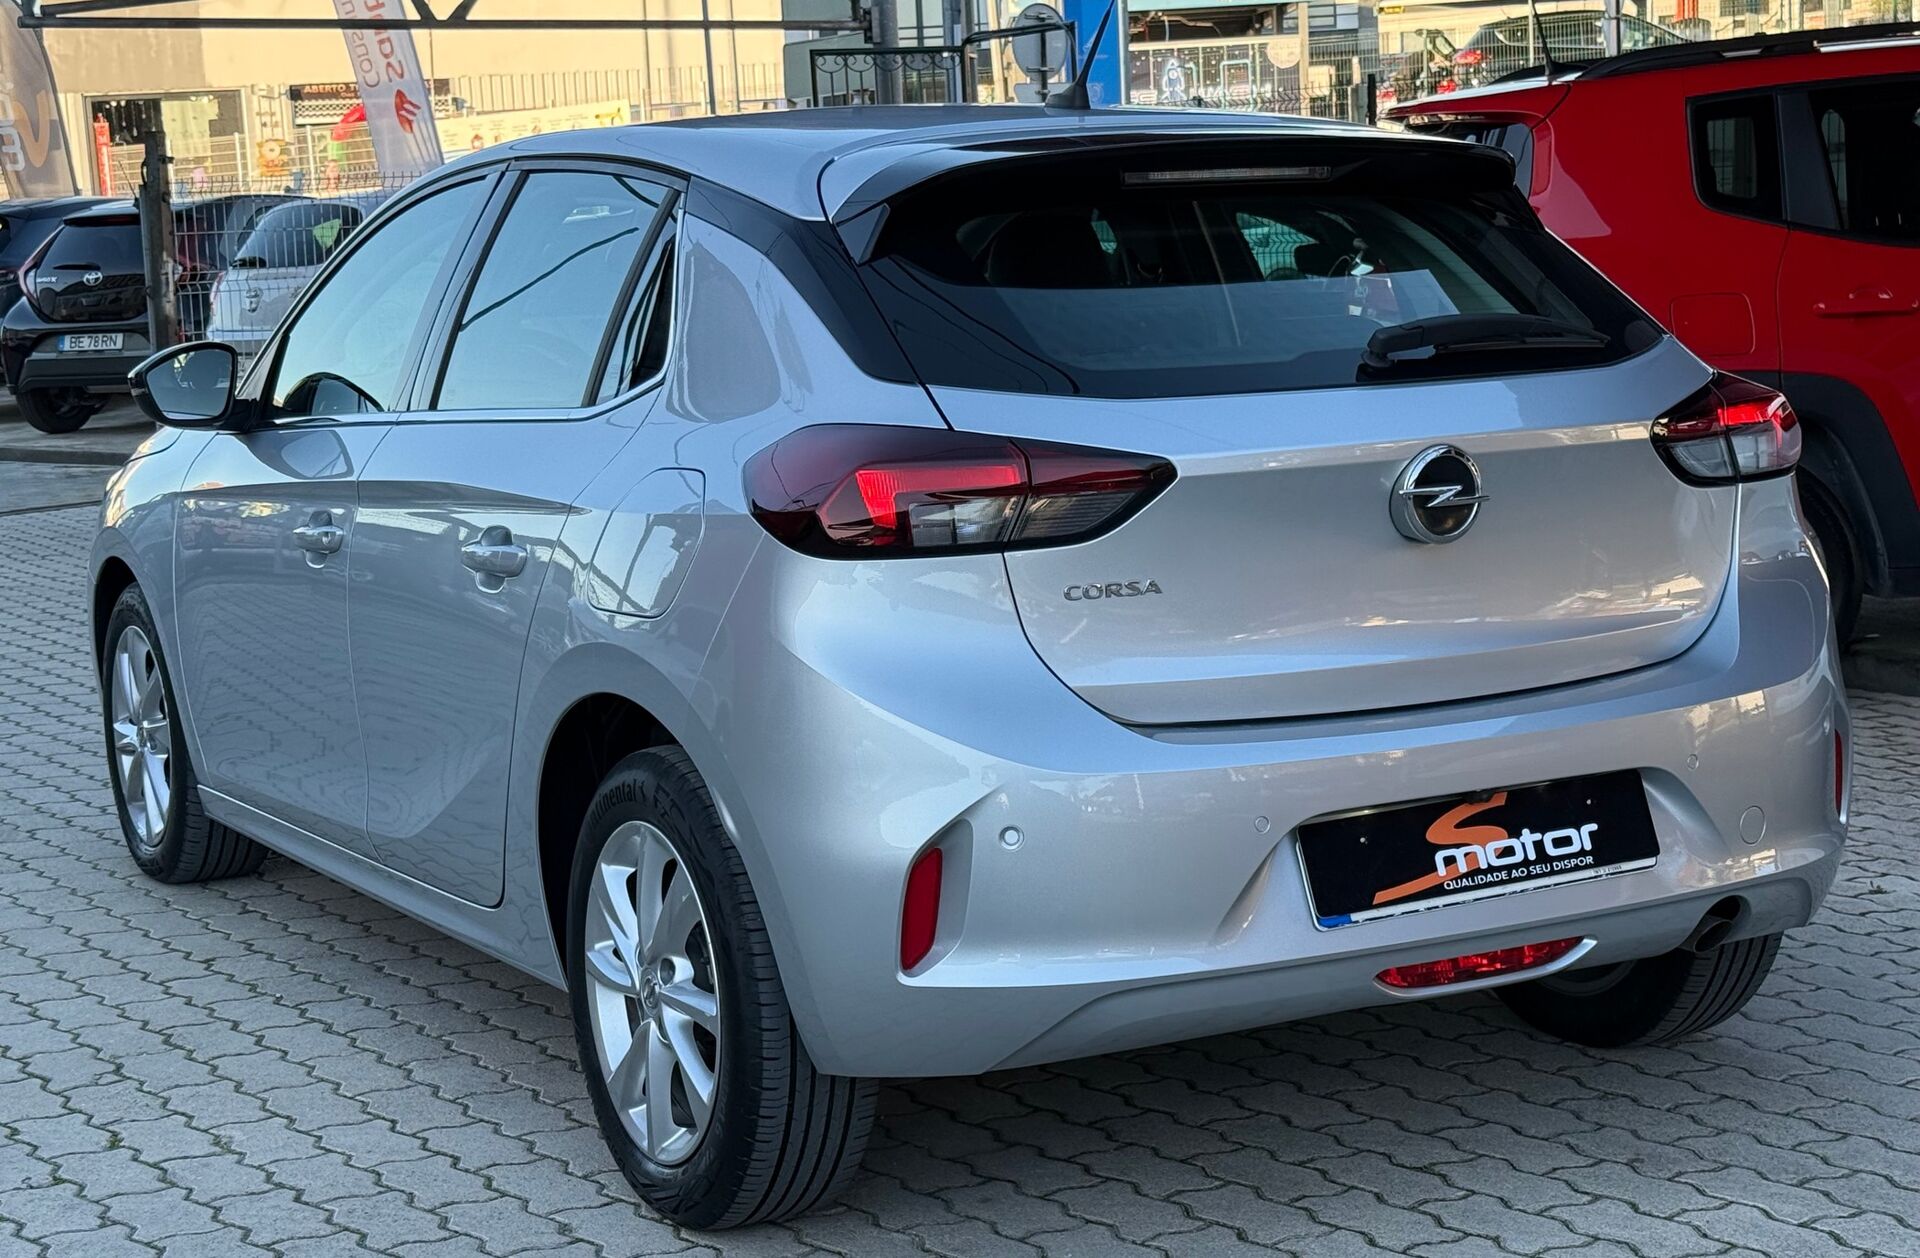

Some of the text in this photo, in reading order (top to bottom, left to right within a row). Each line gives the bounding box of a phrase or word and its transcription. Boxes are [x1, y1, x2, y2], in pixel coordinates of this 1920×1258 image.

[304, 84, 346, 93] ABERTO
[69, 334, 118, 348] BE 78 RN
[1063, 579, 1162, 601] CORSA
[1434, 823, 1598, 876] motor
[1443, 871, 1509, 890] QUALIDADE
[1511, 867, 1527, 878] AO
[1529, 863, 1550, 875] SEU
[1553, 856, 1594, 871] DISPOR
